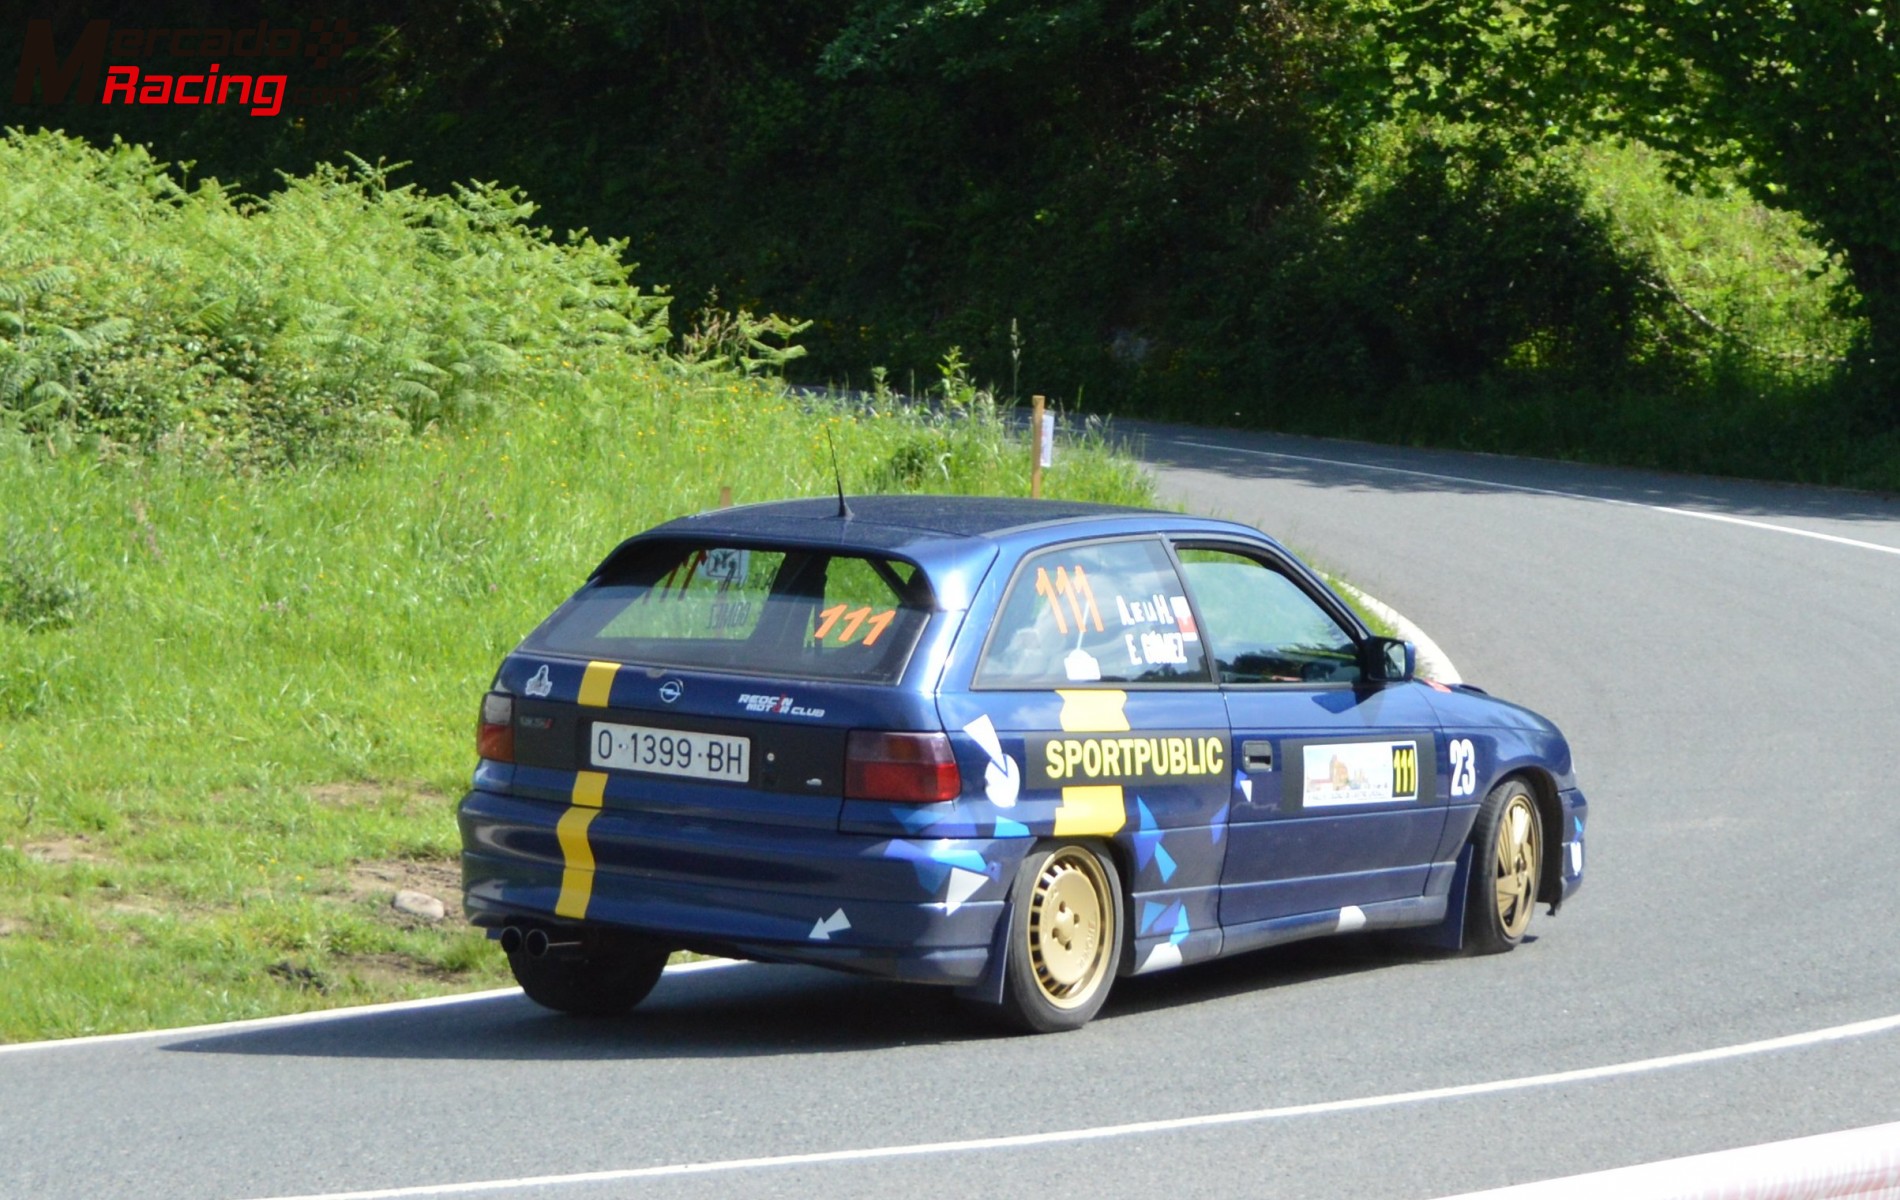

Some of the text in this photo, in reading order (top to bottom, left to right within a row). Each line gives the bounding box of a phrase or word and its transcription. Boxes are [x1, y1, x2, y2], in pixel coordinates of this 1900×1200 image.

[1035, 564, 1105, 634] 111
[814, 603, 896, 646] 111
[790, 706, 826, 718] CLUB
[1046, 737, 1224, 779] SPORTPUBLIC
[1393, 748, 1416, 794] 111
[1449, 738, 1477, 797] 23
